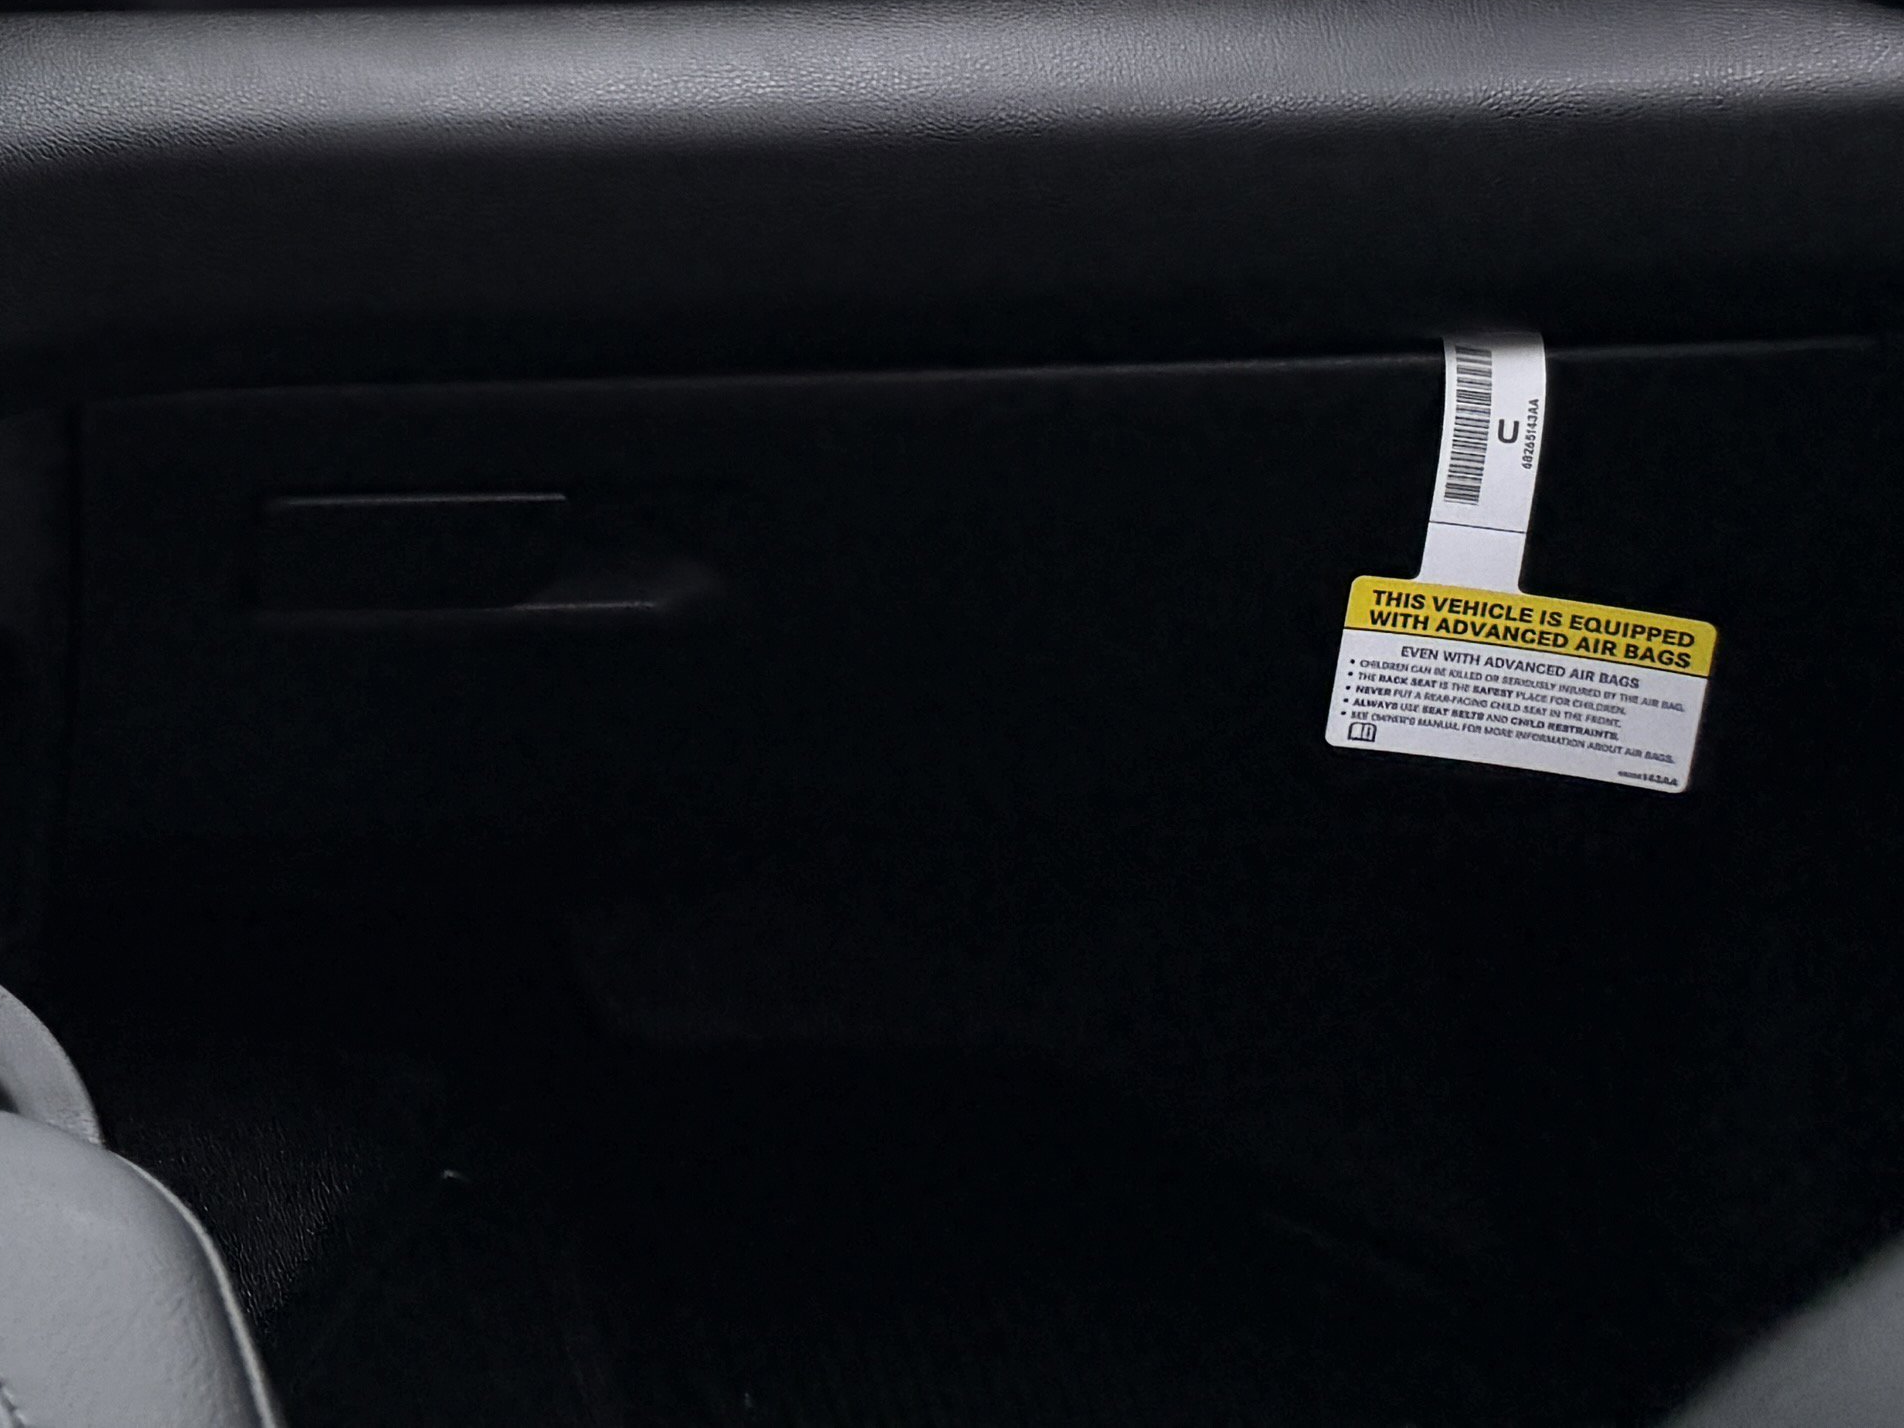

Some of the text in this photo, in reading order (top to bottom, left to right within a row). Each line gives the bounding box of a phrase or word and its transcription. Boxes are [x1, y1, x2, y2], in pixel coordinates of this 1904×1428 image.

[1497, 418, 1520, 444] U
[1372, 589, 1696, 649] THIS VEHICLE IS EQUIPPED
[1369, 609, 1692, 669] WITH ADVANCED AIR BAGS
[1359, 659, 1409, 673] CHILDREN
[1410, 664, 1432, 675] CAN
[1448, 668, 1483, 682] KILLED
[1400, 645, 1640, 690] EVEN WITH ADVANCED AIR BAGS
[1355, 684, 1392, 698] NEVER
[1393, 689, 1413, 700] PUT
[1413, 691, 1422, 701] A
[1489, 700, 1521, 713] CHILD
[1523, 703, 1547, 717] SEAT
[1549, 708, 1561, 719] IN
[1357, 671, 1377, 683] THE
[1378, 673, 1409, 686] BACK
[1410, 677, 1437, 689] SEAT
[1549, 695, 1571, 707] FOR
[1352, 697, 1399, 711] ALWAYS
[1421, 705, 1449, 718] SEAT
[1451, 708, 1485, 722] BELTS
[1486, 712, 1509, 725] AND
[1510, 716, 1545, 729] CHILD
[1461, 723, 1483, 735] FOR
[1484, 725, 1514, 739] MORE
[1586, 741, 1624, 756] ABOUT
